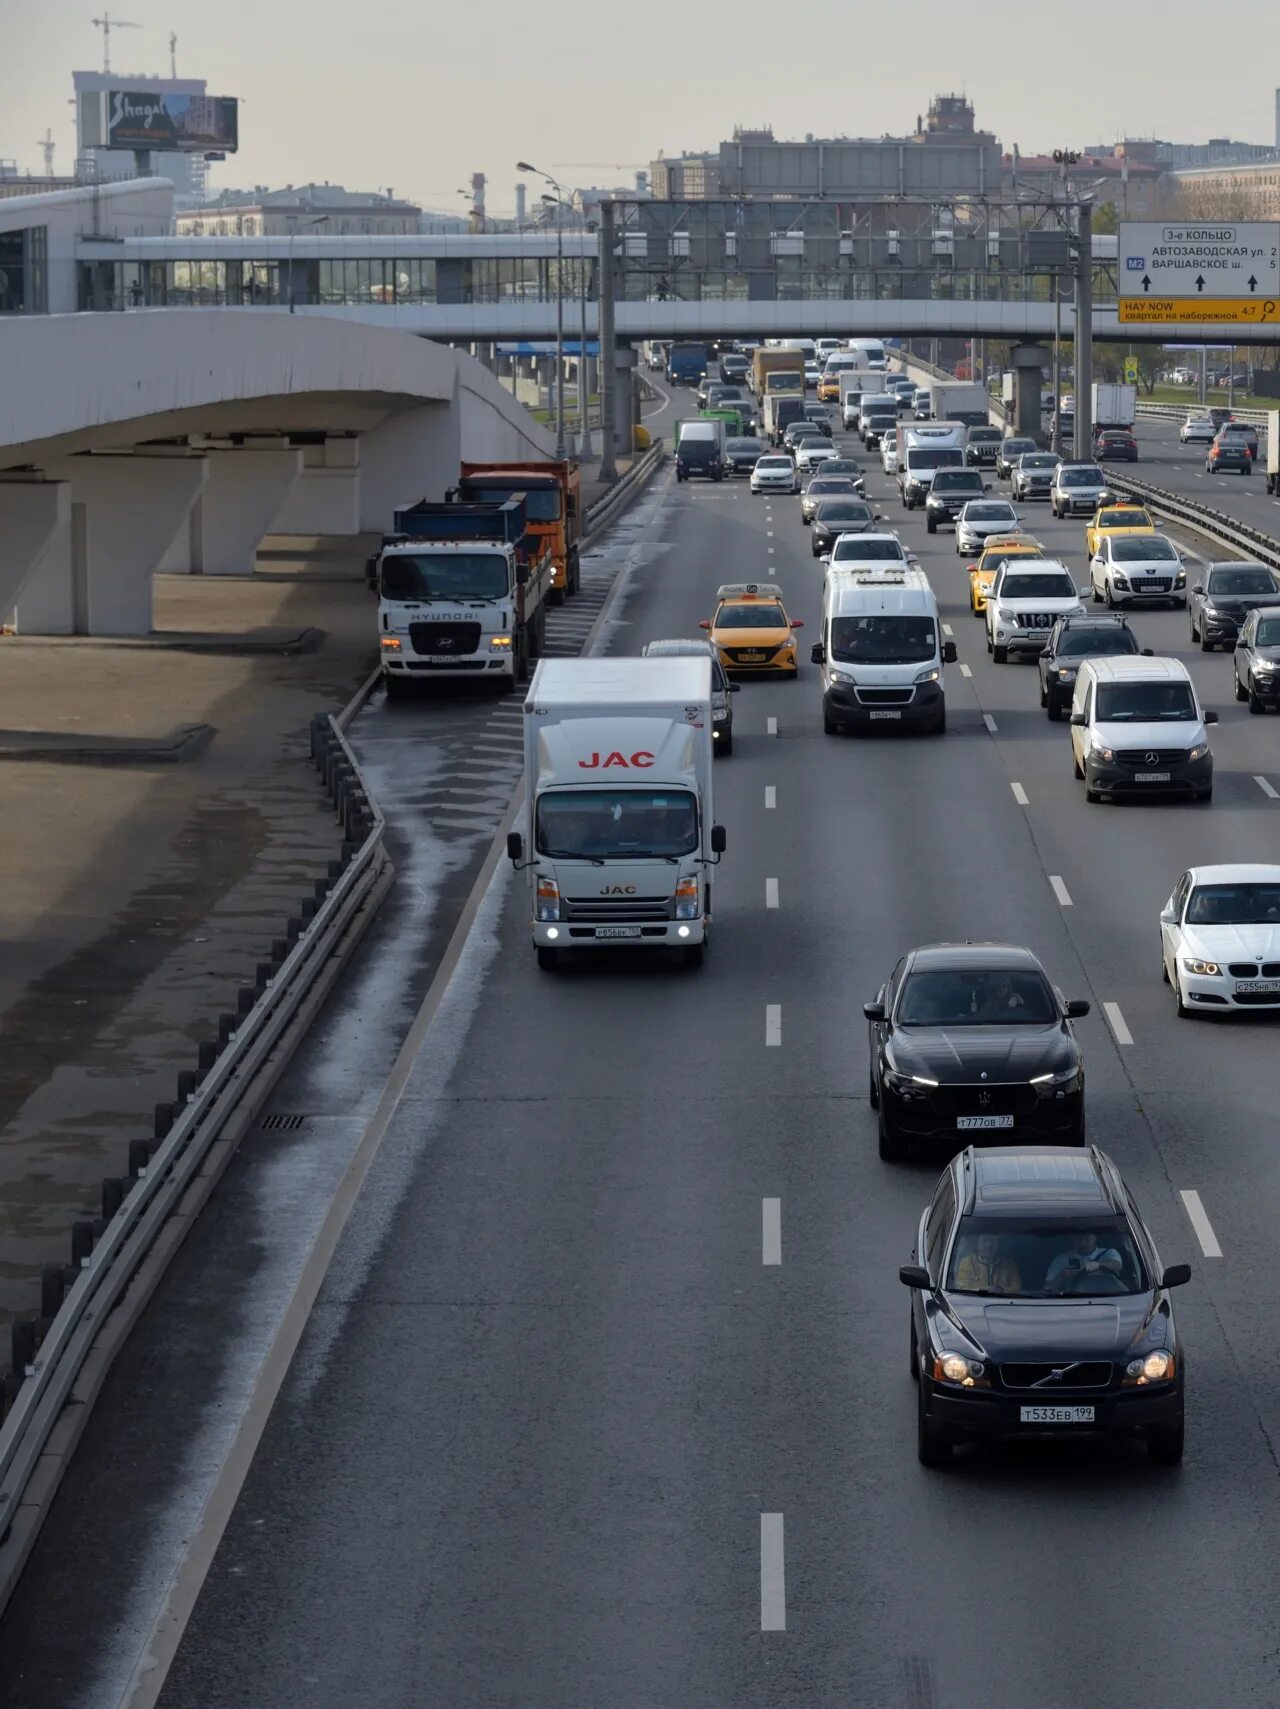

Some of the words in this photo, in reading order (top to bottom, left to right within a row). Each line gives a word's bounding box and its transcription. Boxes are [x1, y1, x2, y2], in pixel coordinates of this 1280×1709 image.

[1168, 231, 1183, 240] 3-е
[1186, 231, 1232, 241] КОЛЬЦО
[1152, 247, 1247, 257] АВТОЗАВОДСКАЯ
[1251, 249, 1266, 258] ул.
[1271, 248, 1277, 256] 2
[1128, 260, 1144, 269] М2
[1152, 260, 1229, 269] ВАРШАВСКОЕ
[1232, 261, 1243, 269] ш.
[1270, 261, 1276, 269] 5
[1125, 313, 1163, 321] квартал
[1179, 312, 1238, 321] набережной
[578, 751, 655, 768] JAC
[599, 886, 636, 895] JAC
[960, 1117, 996, 1127] Т777ОВ
[1001, 1116, 1010, 1124] 77
[1024, 1408, 1071, 1420] Т533ЕВ
[1074, 1407, 1092, 1417] 199
